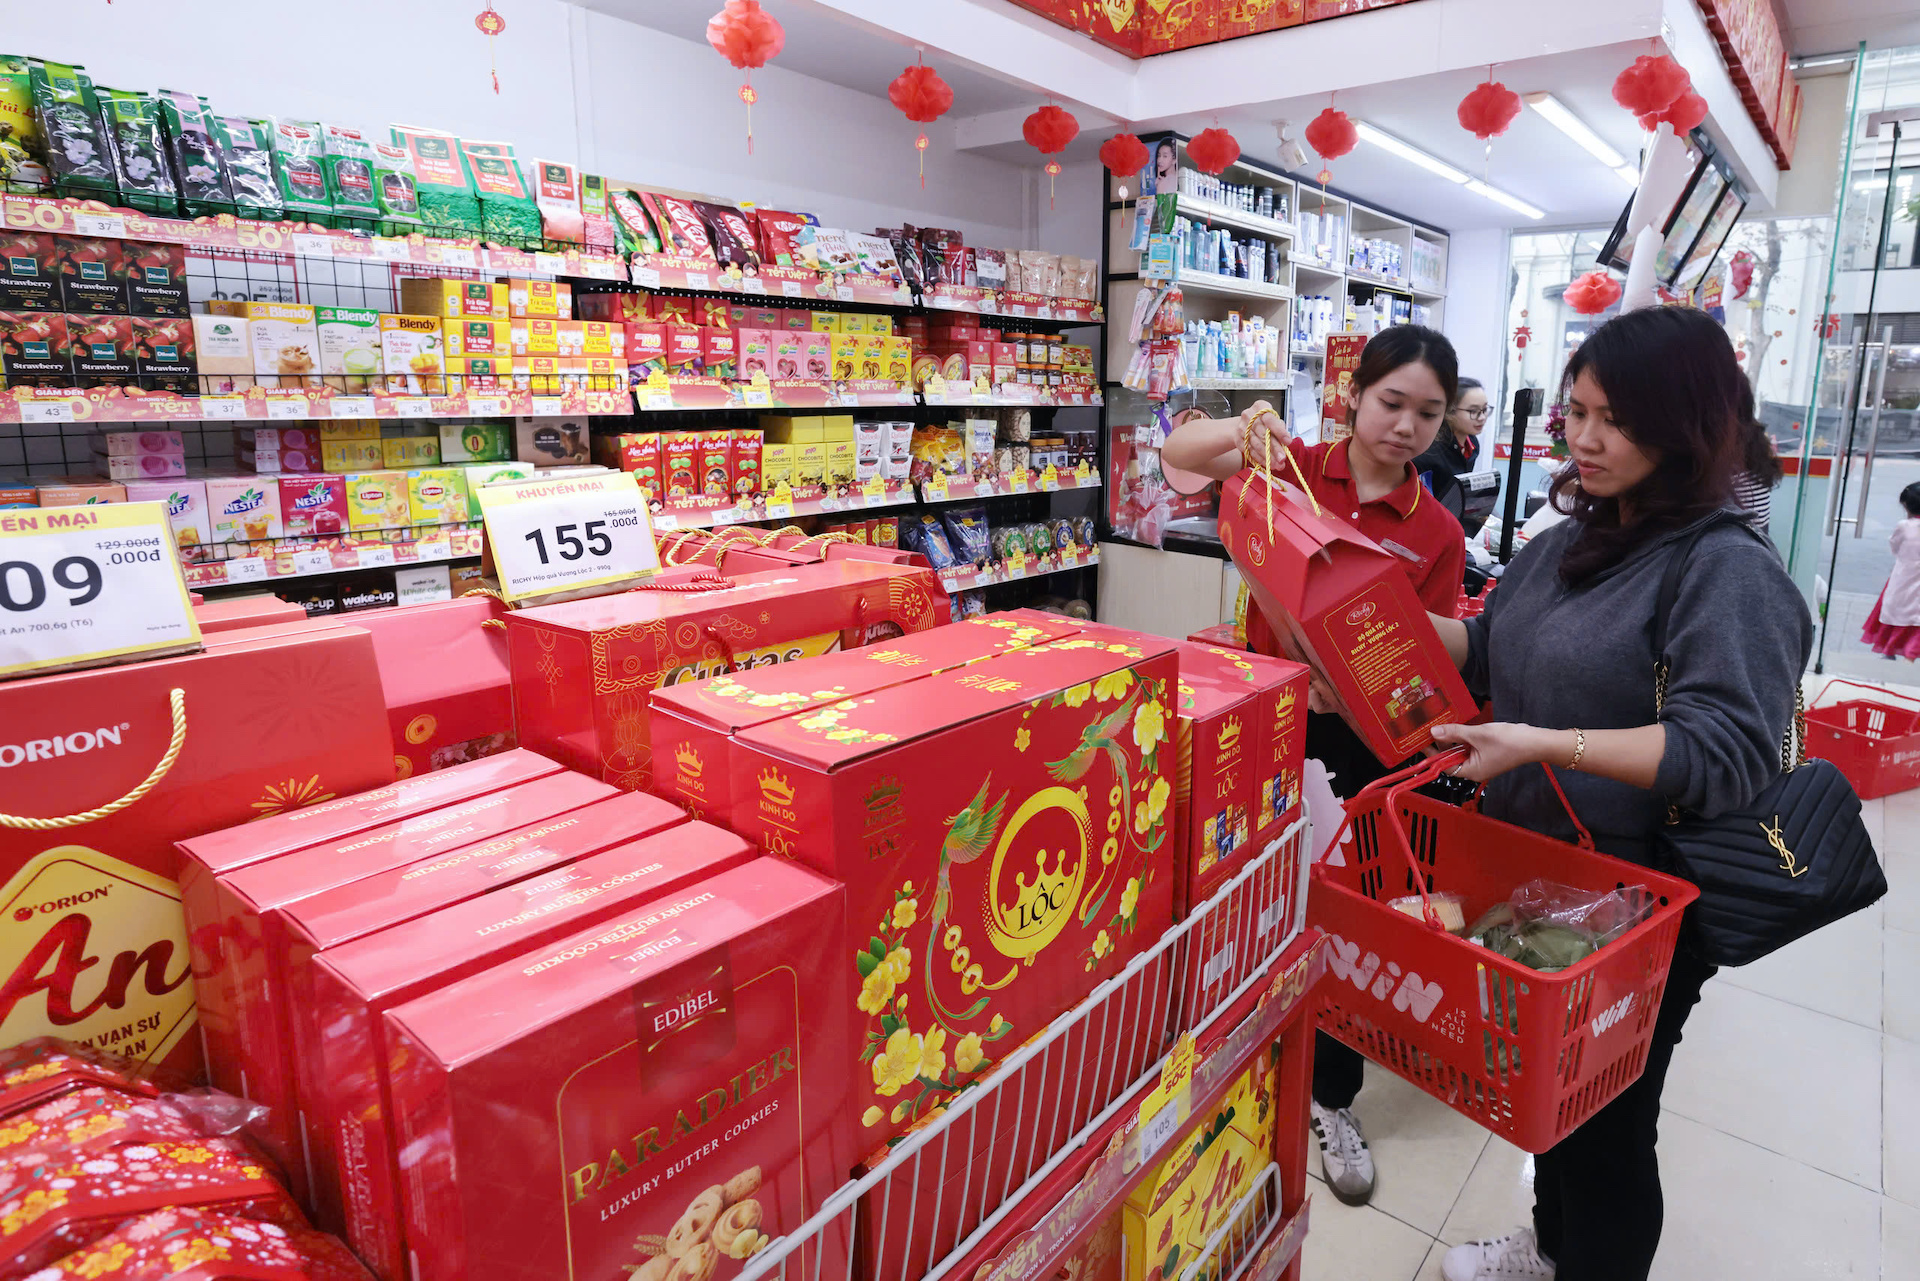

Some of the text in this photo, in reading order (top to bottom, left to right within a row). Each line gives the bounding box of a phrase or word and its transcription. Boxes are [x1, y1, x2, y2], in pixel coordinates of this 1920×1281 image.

[0, 277, 53, 289] Strawberry
[70, 281, 120, 293] Strawberry
[135, 286, 181, 297] Strawberry
[269, 305, 313, 320] Blendy
[336, 309, 378, 324] Blendy
[398, 317, 436, 331] Blendy
[12, 361, 65, 371] Strawberry
[81, 362, 131, 373] Strawberry
[145, 364, 191, 374] Strawberry
[45, 408, 60, 417] 43
[222, 404, 236, 413] 37
[286, 406, 298, 414] 36
[361, 491, 384, 500] Lipton
[422, 487, 444, 496] Lipton
[516, 480, 604, 500] KHUYẾN MẠI
[224, 499, 265, 514] NESTEA
[295, 494, 334, 508] NESTEA
[46, 511, 98, 529] MẠI
[609, 516, 639, 529] .000đ
[95, 537, 160, 551] 129.000đ
[525, 520, 612, 566] 155
[105, 549, 161, 566] .000đ
[310, 557, 322, 565] 42
[374, 554, 386, 562] 40
[243, 564, 256, 573] 32
[512, 576, 532, 585] RICHY
[533, 574, 546, 583] Hộp
[558, 569, 577, 578] Vương
[0, 555, 103, 612] 09
[70, 618, 93, 629] (T6)
[1273, 714, 1295, 733] KINH DO
[0, 724, 122, 768] ORION
[1216, 744, 1241, 766] KINH DO
[1273, 738, 1293, 764] LỘC
[677, 773, 705, 793] KINH DO
[1216, 770, 1239, 800] LỘC
[759, 800, 797, 822] KINH DO
[527, 817, 580, 841] LUXURY
[1758, 813, 1809, 879] YSL
[400, 855, 472, 881] COOKIES
[489, 849, 545, 871] EDIBEL
[524, 873, 581, 897] EDIBEL
[39, 885, 109, 915] ORION
[475, 861, 664, 937] LUXURY BUTTER COOKIES
[1016, 882, 1066, 933] LỘC
[522, 891, 716, 977] LUXURY BUTTER COOKIES
[622, 935, 684, 964] EDIBEL
[0, 913, 191, 1026] An
[653, 988, 719, 1034] EDIBEL
[1444, 1012, 1466, 1028] ALL
[1455, 1007, 1467, 1019] IS
[97, 1011, 161, 1047] VẠN SỰ
[1431, 1022, 1465, 1045] NEED
[1440, 1017, 1466, 1036] YOU
[1164, 1065, 1188, 1096] SỐC
[569, 1045, 797, 1205] PARADIER
[1153, 1117, 1171, 1140] 105
[600, 1099, 780, 1222] LUXURY BUTTER COOKIES
